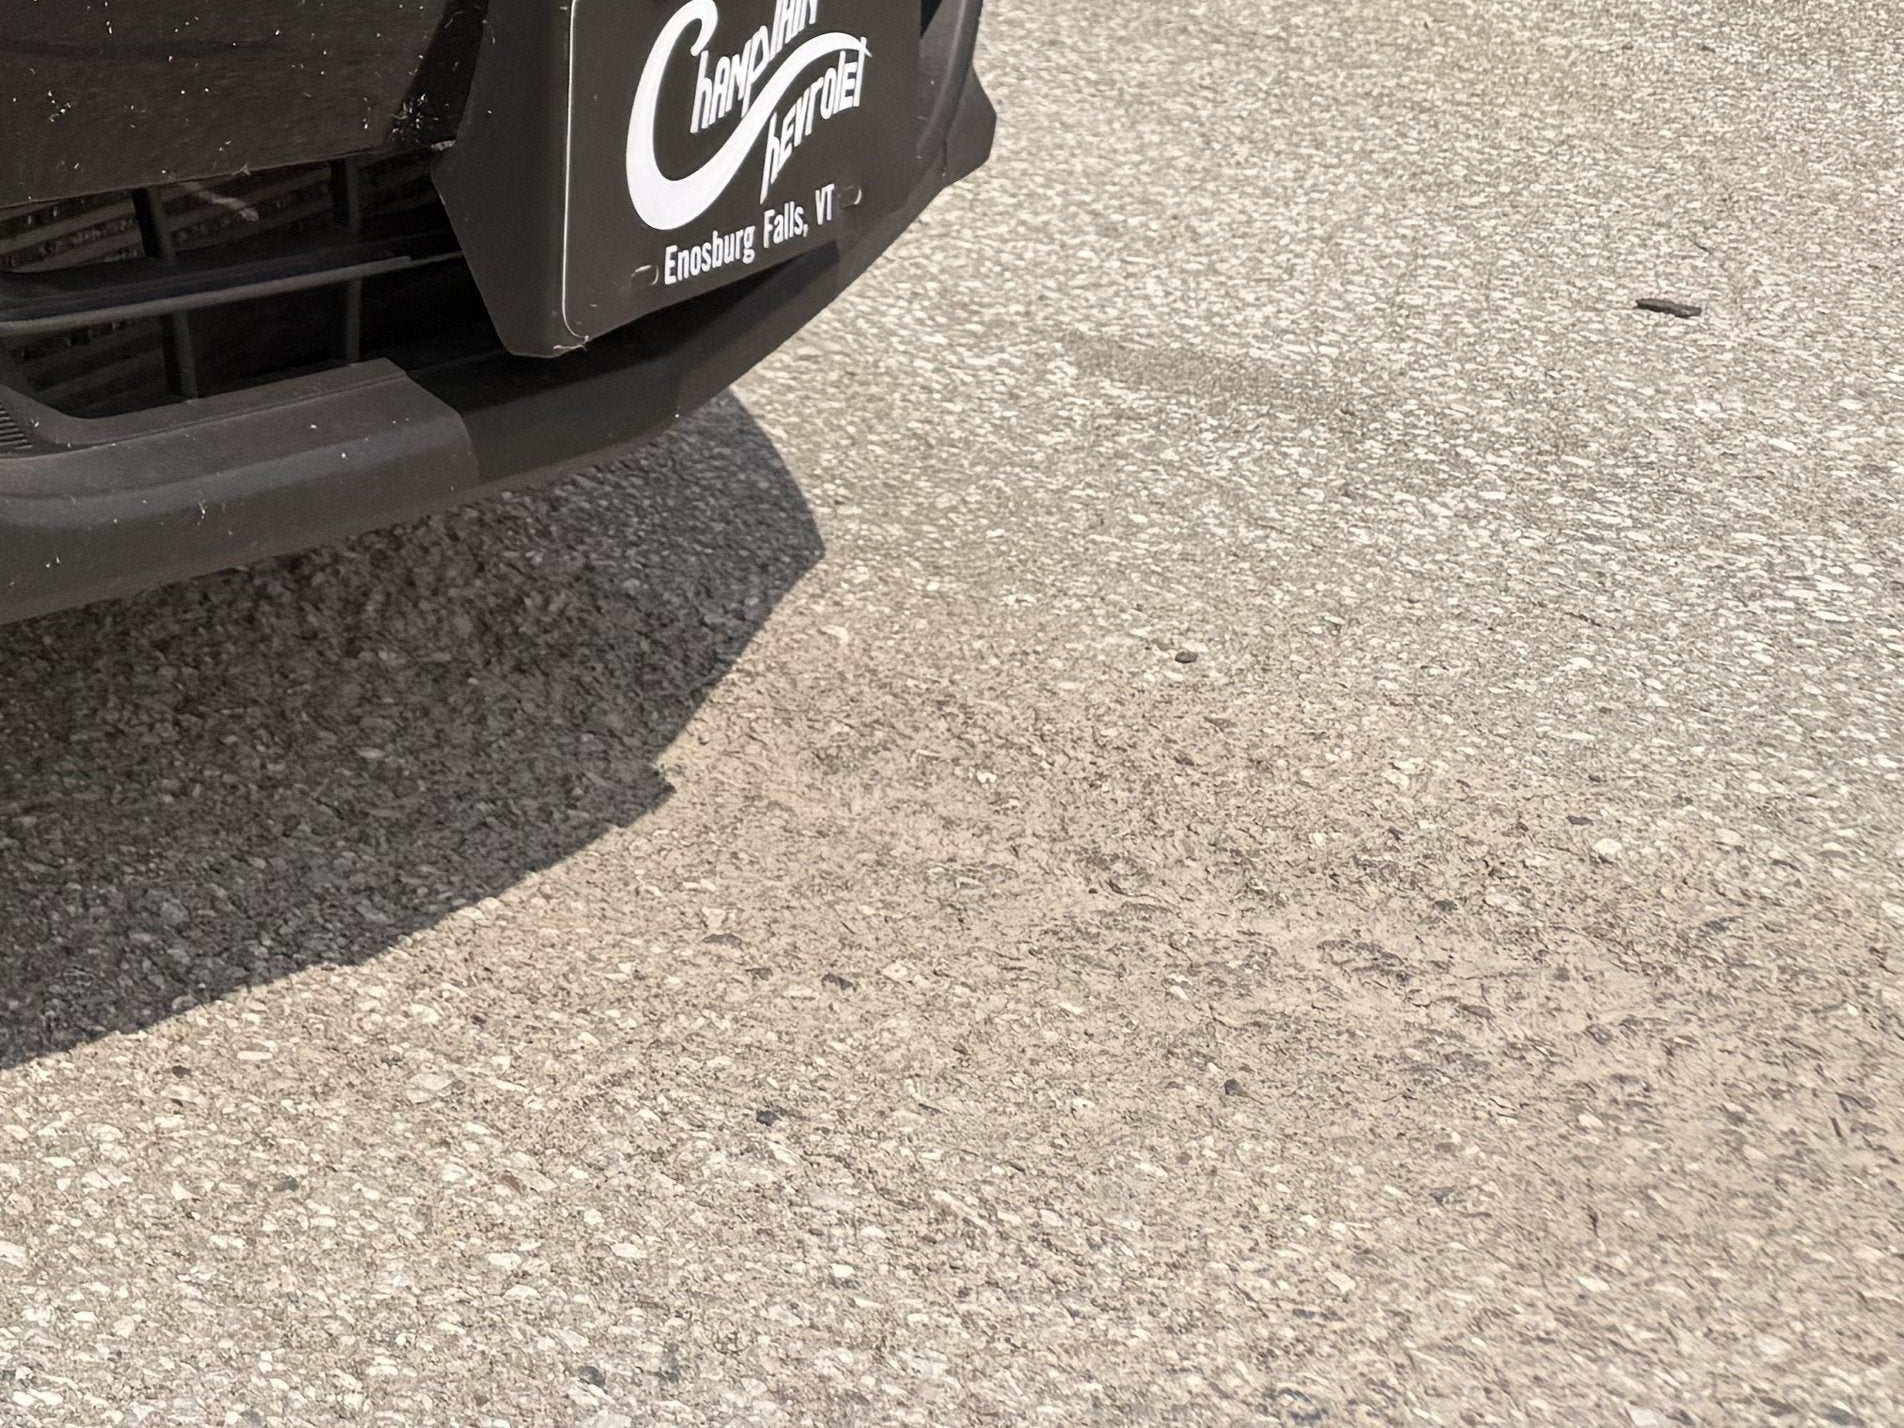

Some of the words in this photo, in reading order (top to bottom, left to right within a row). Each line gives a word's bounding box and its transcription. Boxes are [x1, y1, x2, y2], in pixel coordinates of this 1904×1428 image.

[664, 225, 756, 285] Enosburg
[763, 200, 809, 249] Falls,
[814, 183, 835, 226] VT
